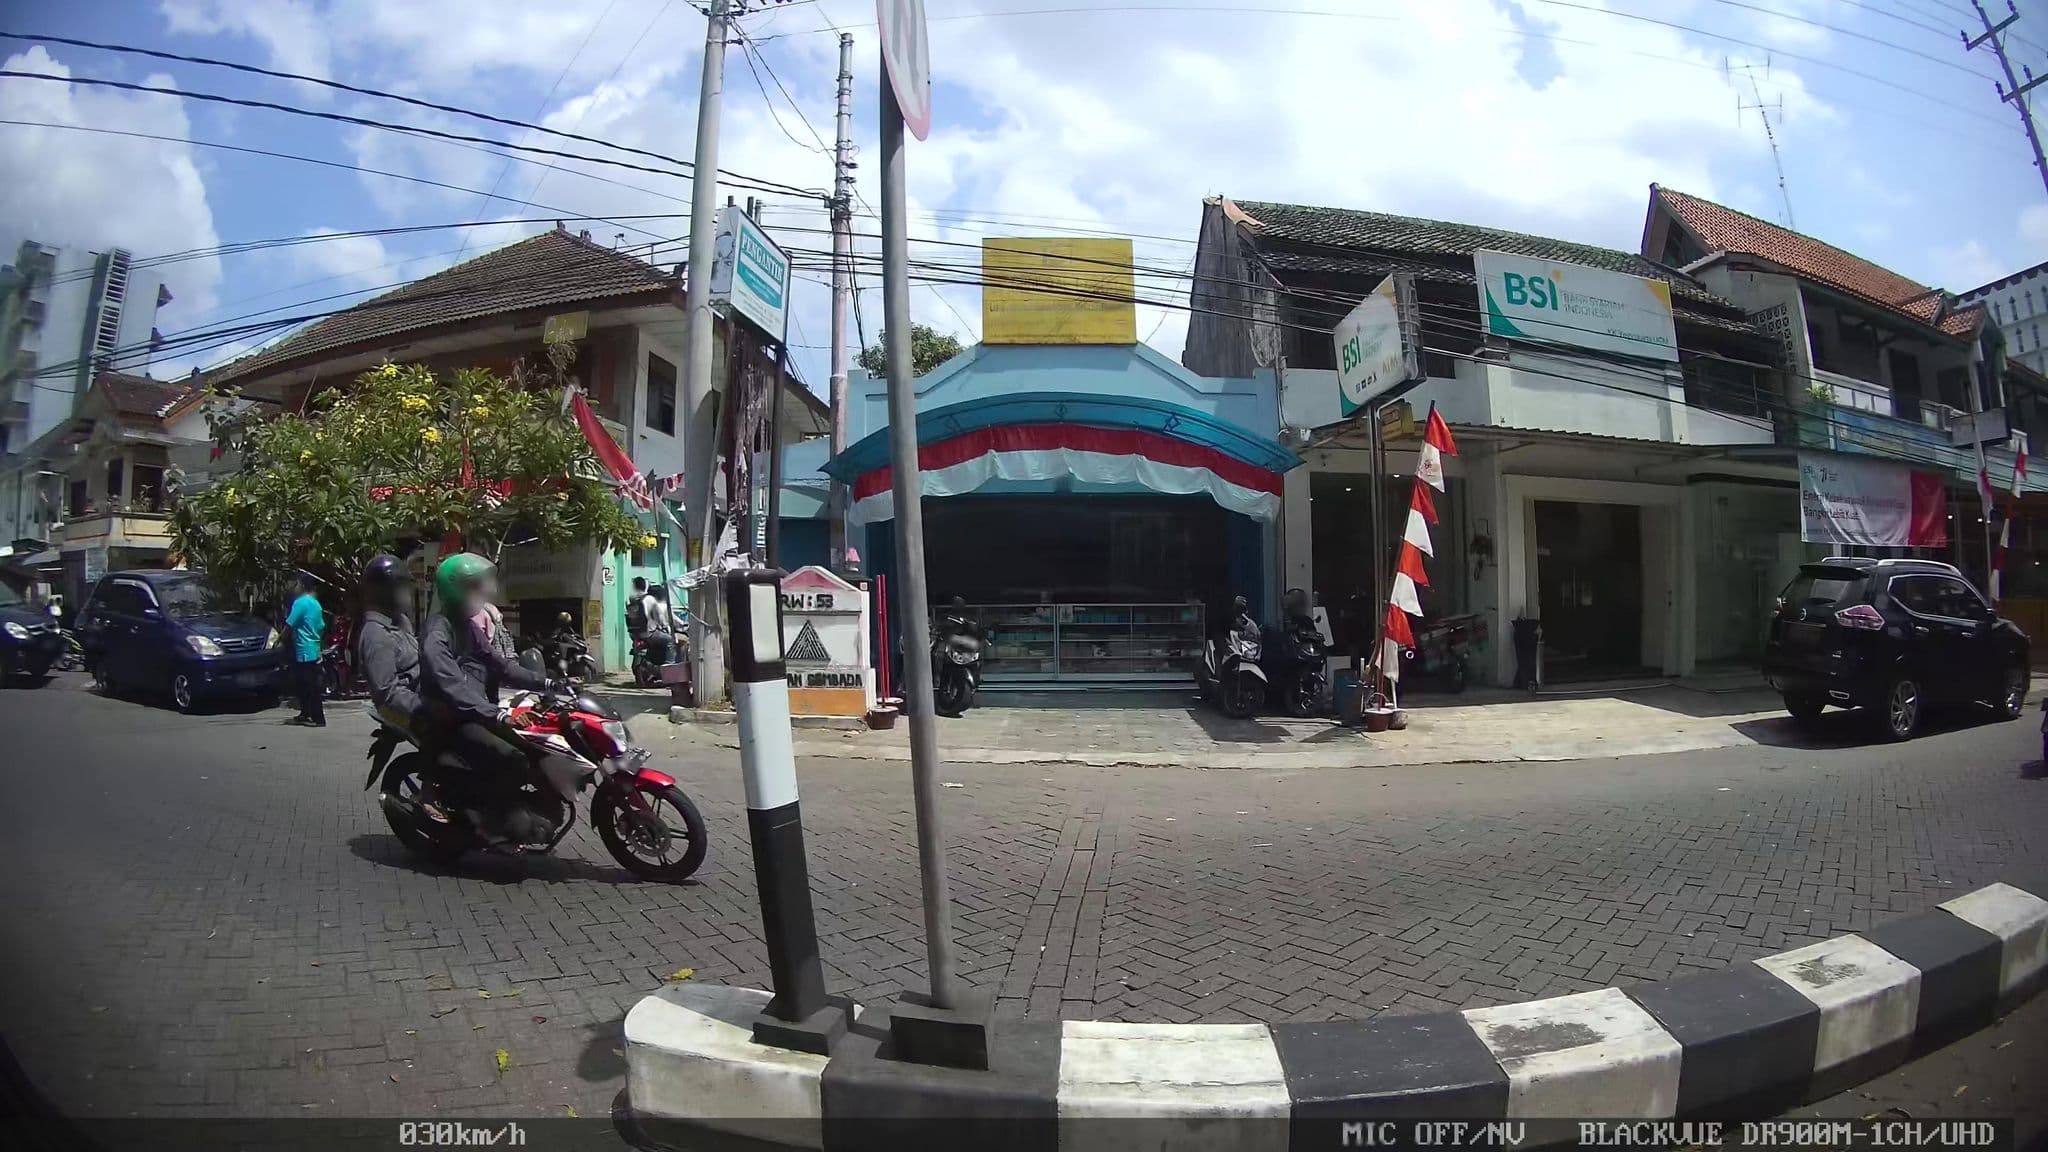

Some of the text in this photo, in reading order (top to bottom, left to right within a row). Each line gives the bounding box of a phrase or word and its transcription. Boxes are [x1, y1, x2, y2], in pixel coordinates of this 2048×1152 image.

[1504, 271, 1559, 311] BSI
[1342, 335, 1362, 375] BSI
[807, 673, 863, 688] SEMBADA
